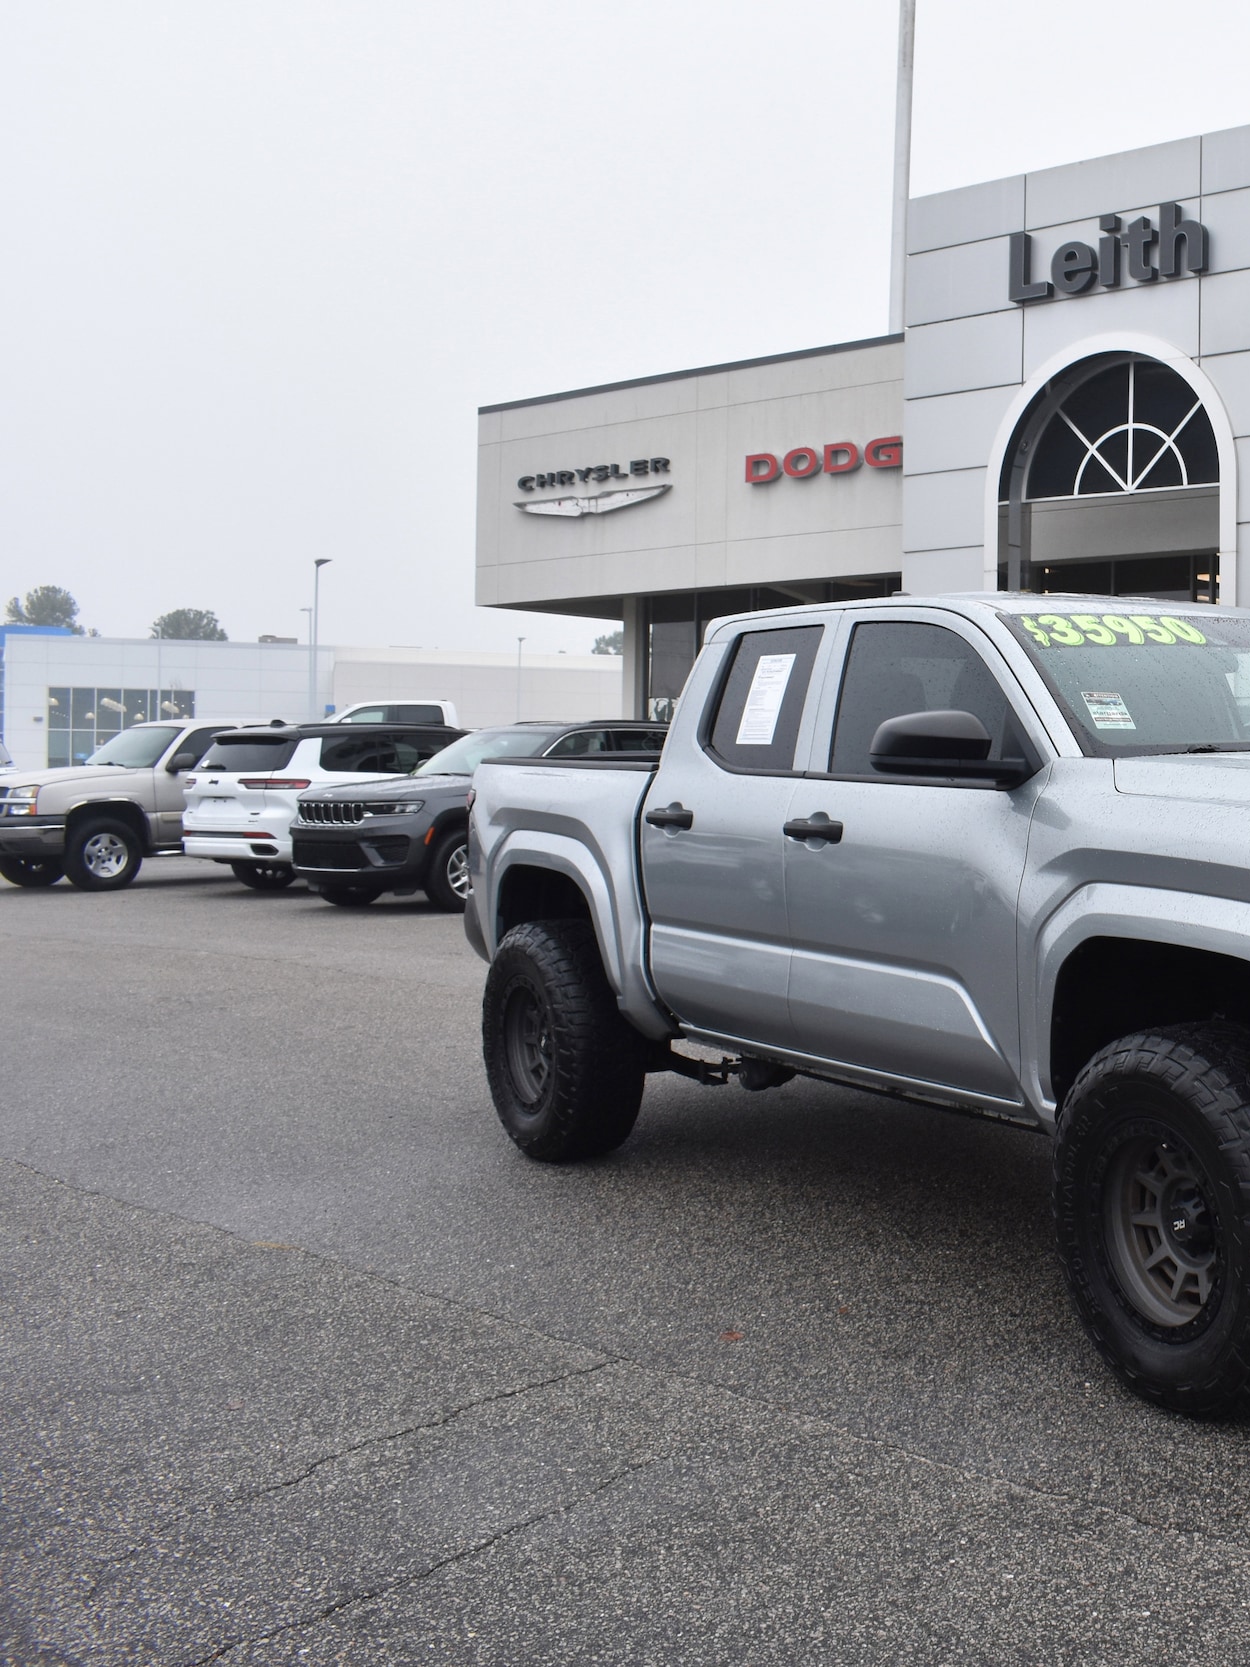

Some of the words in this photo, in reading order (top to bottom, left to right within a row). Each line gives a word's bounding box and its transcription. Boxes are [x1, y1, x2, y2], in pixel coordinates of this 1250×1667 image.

[1008, 202, 1209, 304] Leith
[517, 456, 671, 492] CHRYSLER
[745, 435, 903, 485] DODG
[1021, 613, 1207, 648] $35950
[1173, 1218, 1186, 1231] RC
